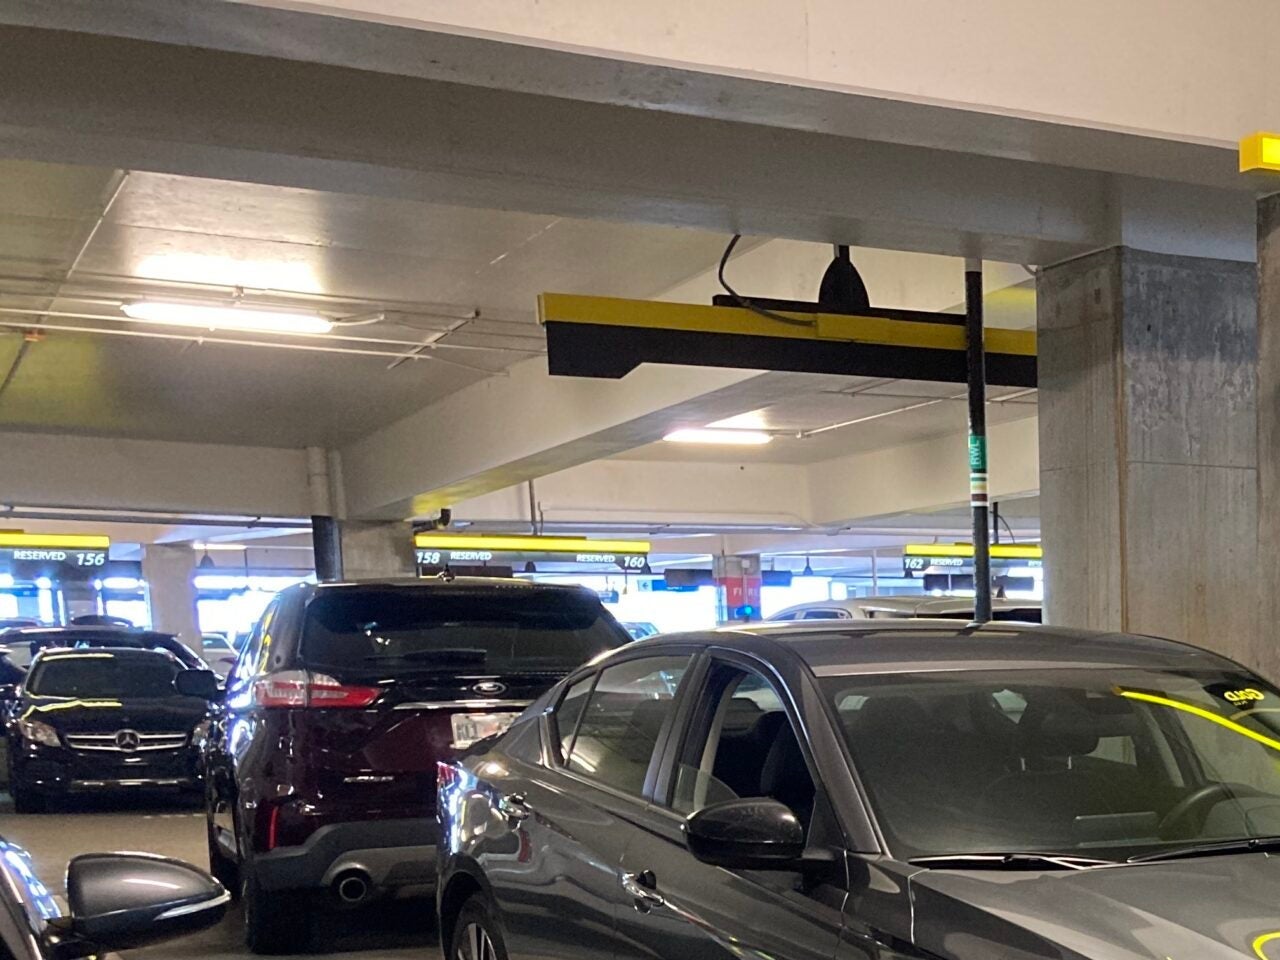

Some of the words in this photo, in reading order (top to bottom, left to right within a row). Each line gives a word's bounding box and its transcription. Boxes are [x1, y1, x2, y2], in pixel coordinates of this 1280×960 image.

[13, 550, 67, 561] RESERVED
[76, 553, 106, 566] 156
[416, 551, 441, 565] 158
[450, 551, 493, 562] RESERVED
[576, 553, 616, 564] RESERVED
[623, 556, 646, 569] 160
[904, 558, 924, 569] 162
[930, 557, 964, 567] RESERVED
